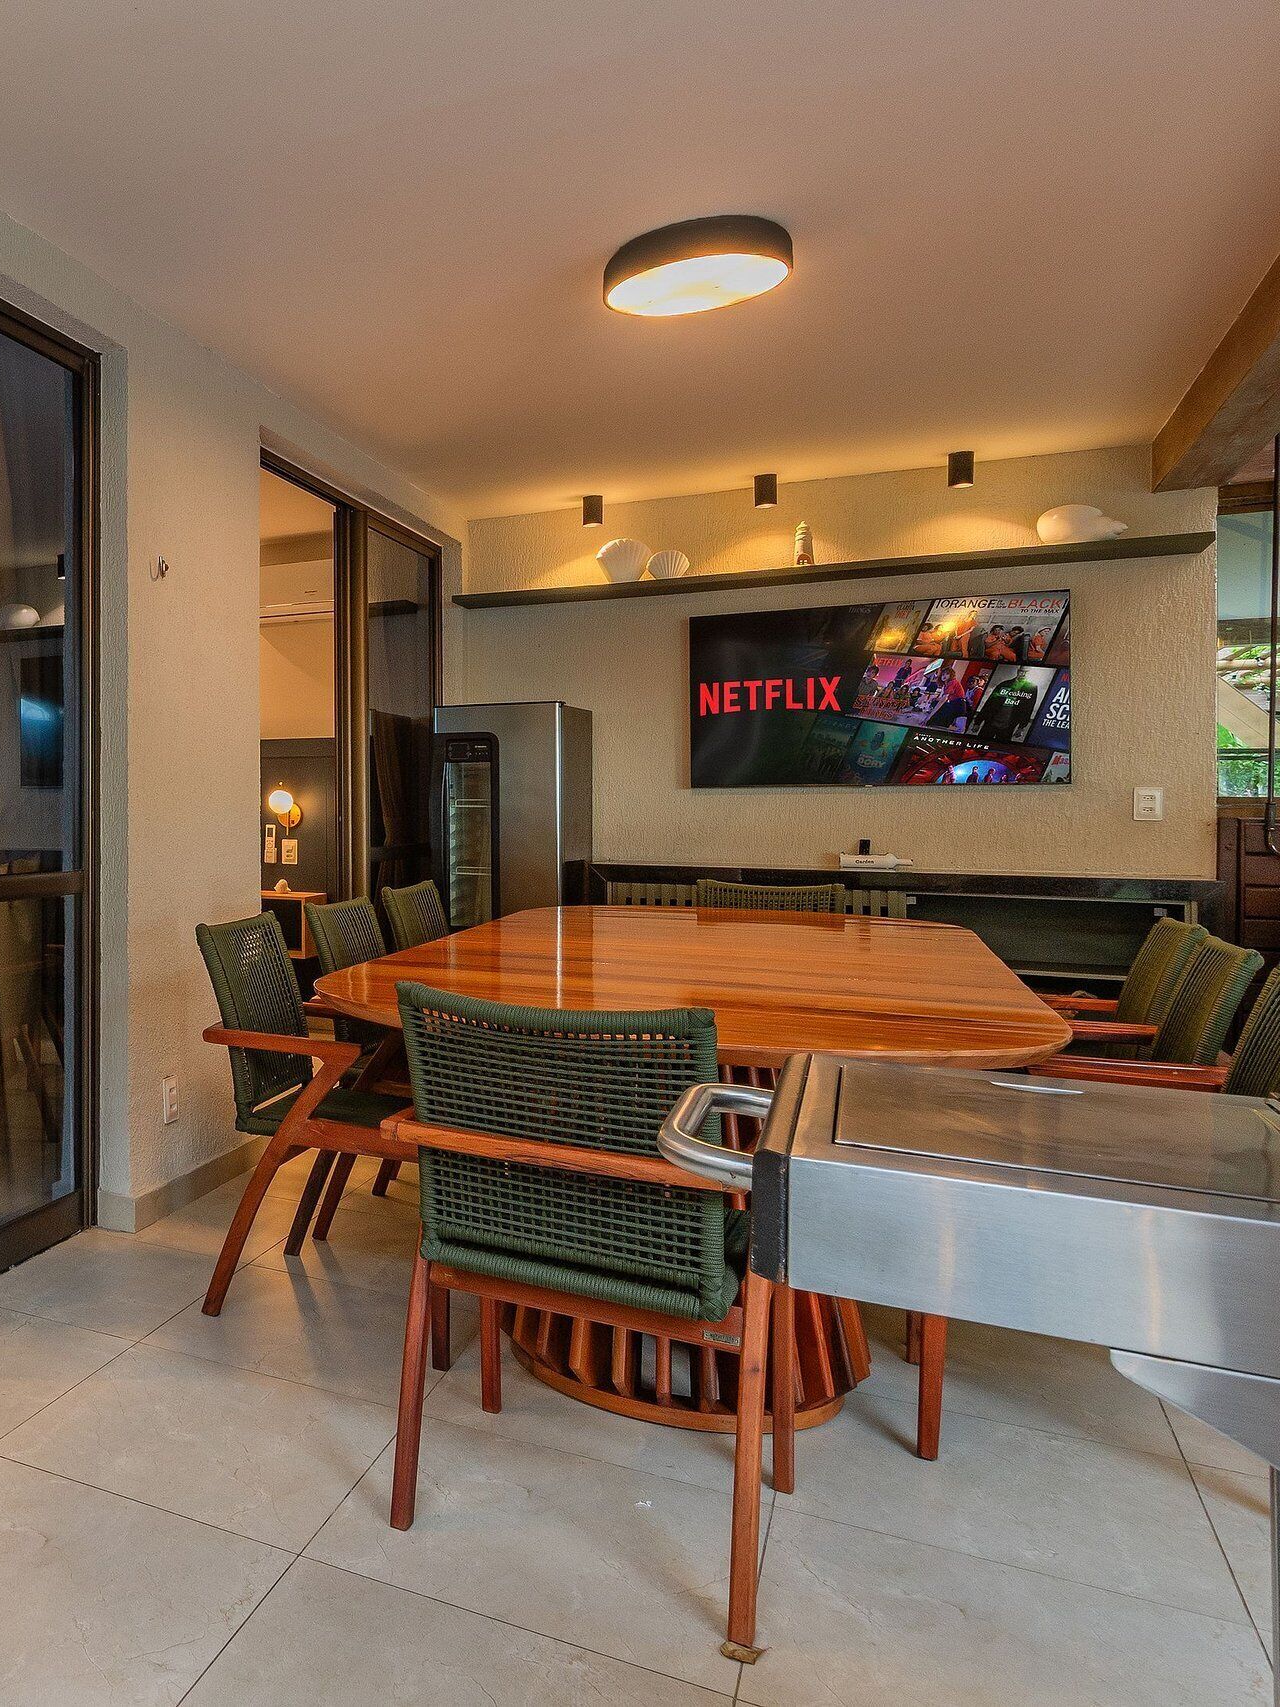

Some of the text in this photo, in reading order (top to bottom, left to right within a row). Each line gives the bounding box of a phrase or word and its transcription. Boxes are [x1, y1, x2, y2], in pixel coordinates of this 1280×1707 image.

[940, 599, 995, 609] ORANGE
[1007, 597, 1061, 609] BLACK
[699, 676, 841, 717] NETFLIX
[999, 688, 1033, 699] Breaking
[1004, 698, 1021, 706] Bad
[1042, 718, 1056, 727] THE
[913, 735, 962, 746] ANOTHER
